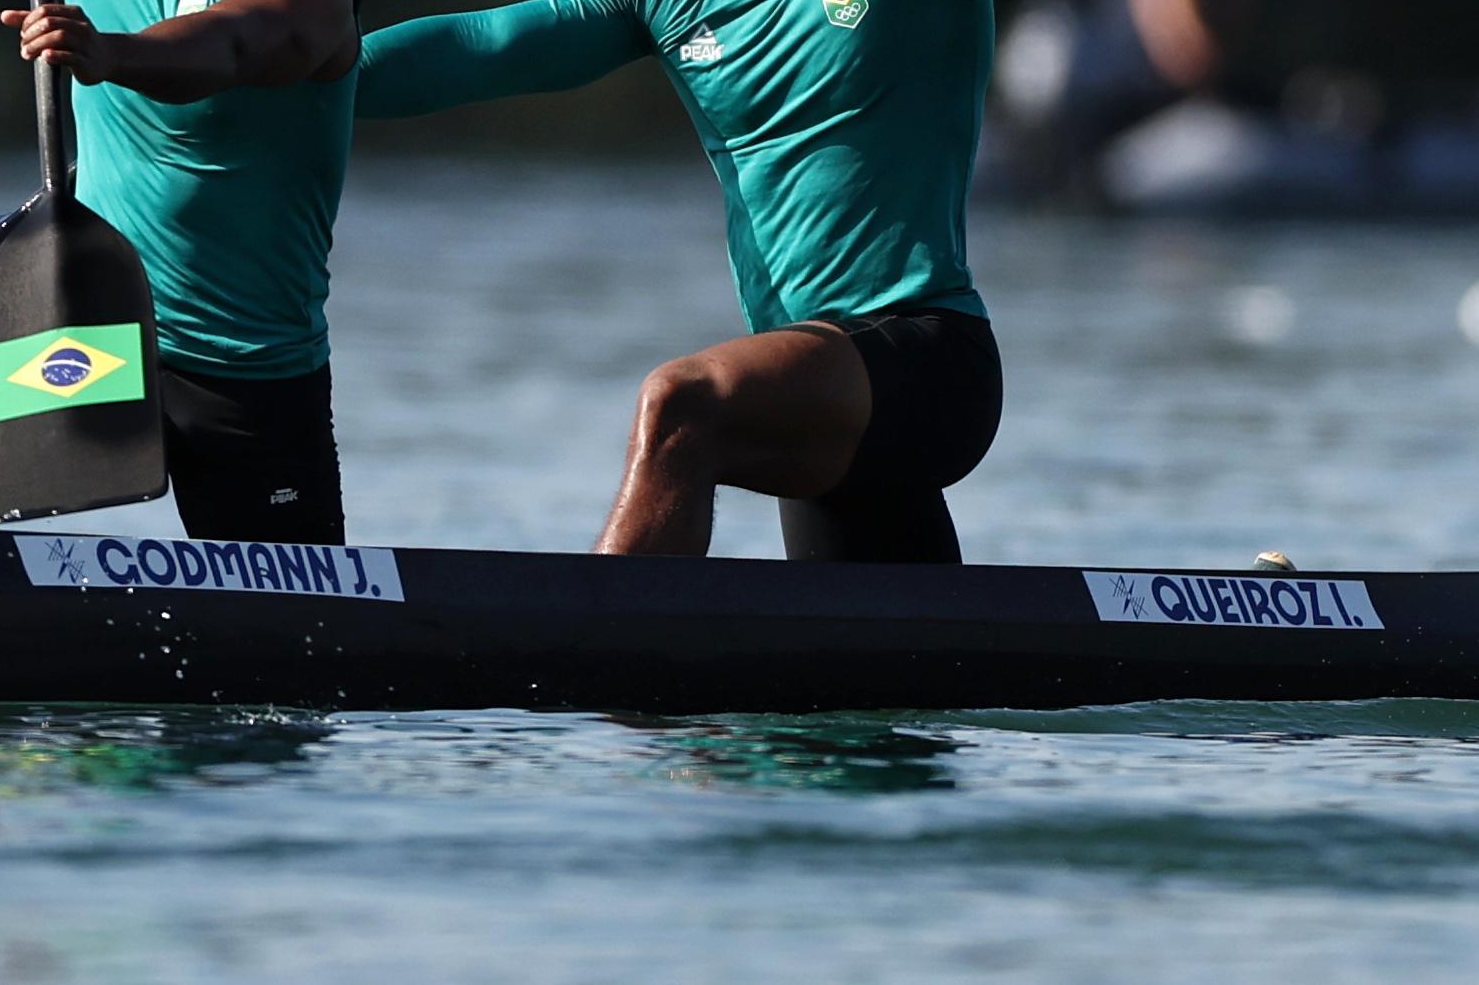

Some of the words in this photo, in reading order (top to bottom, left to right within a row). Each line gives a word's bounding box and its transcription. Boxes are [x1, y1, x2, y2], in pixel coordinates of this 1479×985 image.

[680, 44, 724, 62] PEAK
[270, 490, 298, 504] PEAK
[96, 538, 341, 594] GODMANN
[346, 548, 382, 598] J.
[1151, 575, 1334, 626] QUEIROZ
[1328, 582, 1364, 627] I.
